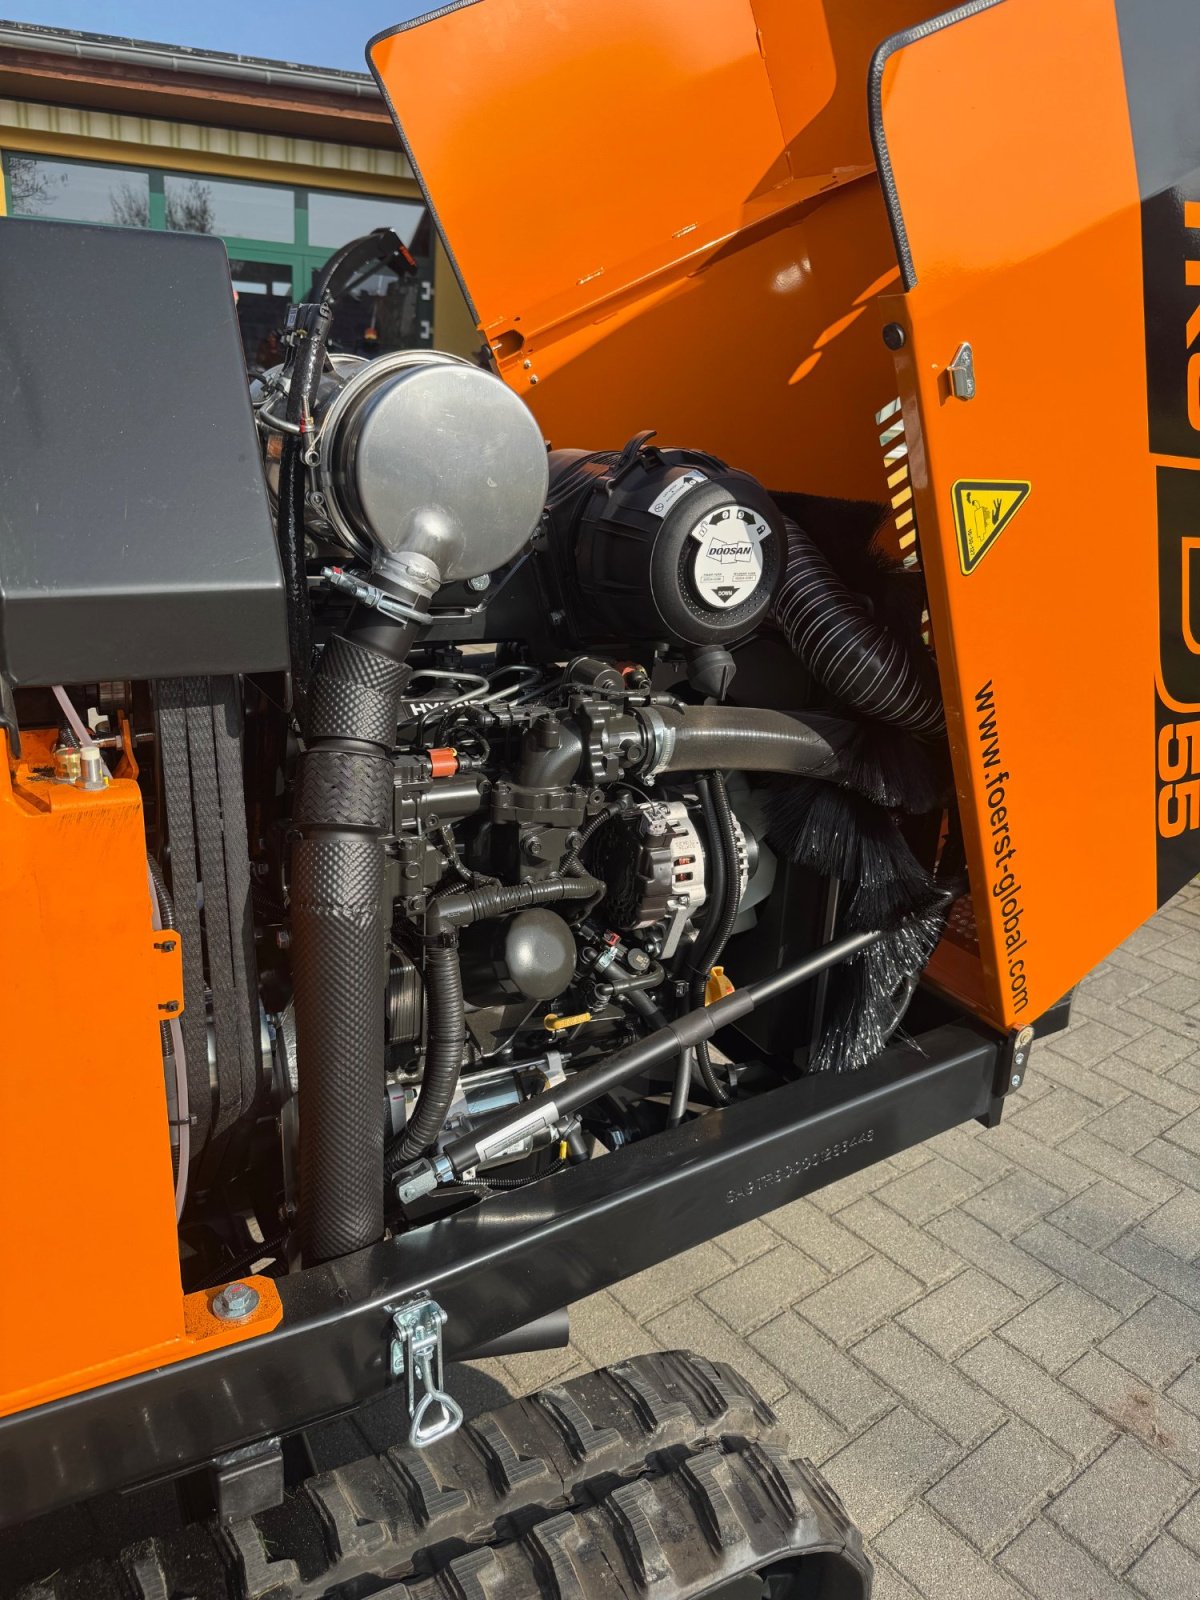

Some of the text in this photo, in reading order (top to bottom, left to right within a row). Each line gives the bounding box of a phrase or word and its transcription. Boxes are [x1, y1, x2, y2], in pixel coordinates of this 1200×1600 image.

[708, 546, 752, 556] DOOSAN
[1158, 720, 1200, 839] 55
[975, 679, 1030, 1015] www.foerst-global.com
